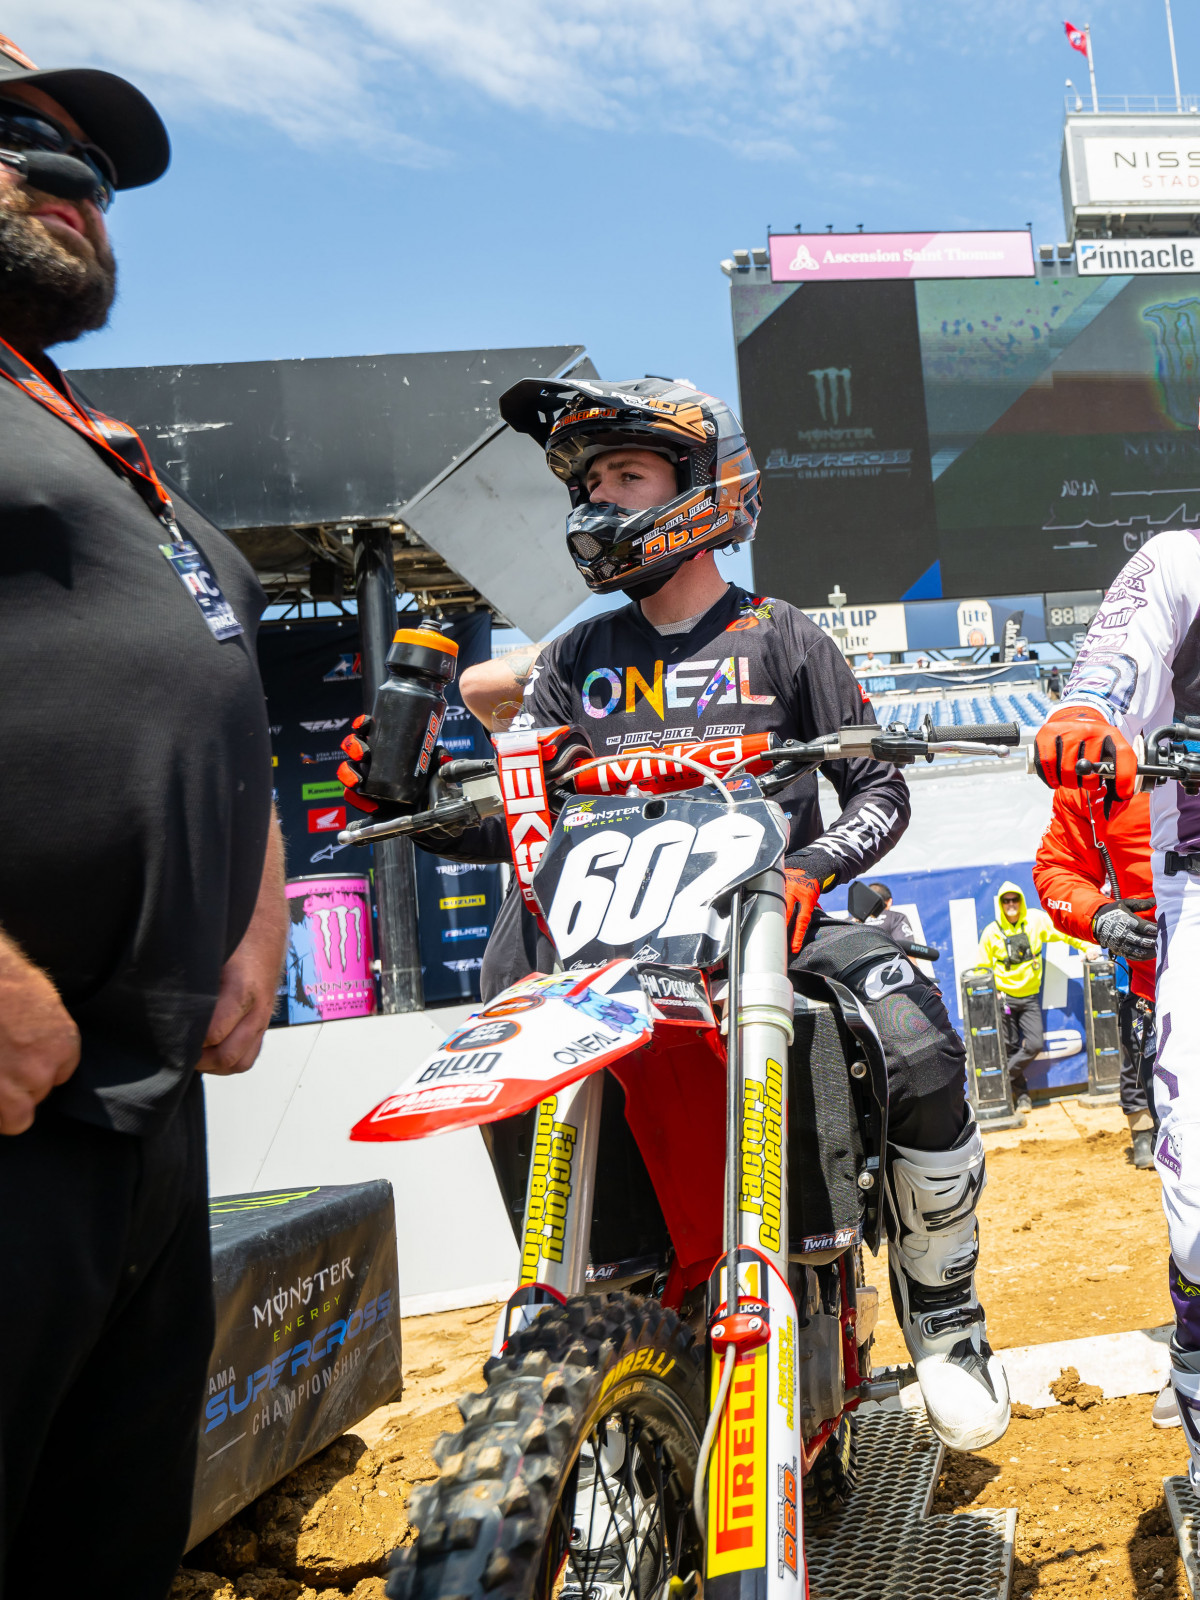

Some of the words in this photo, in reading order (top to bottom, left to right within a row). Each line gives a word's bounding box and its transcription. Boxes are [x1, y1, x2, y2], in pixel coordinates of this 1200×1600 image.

[823, 249, 900, 264] Ascension
[903, 248, 943, 262] Saint
[945, 247, 1005, 262] Thomas
[1082, 244, 1195, 270] Pinnacle
[808, 611, 845, 629] TAN
[850, 609, 877, 627] UP
[963, 609, 988, 626] Lite
[445, 739, 472, 748] YAMAHA
[623, 731, 652, 745] DIRT
[662, 727, 695, 740] BIKE
[704, 724, 745, 737] DEPOT
[307, 786, 345, 795] Kawasaki
[615, 770, 699, 791] Metals
[501, 755, 550, 885] EKS
[592, 806, 641, 823] NSTER
[549, 813, 766, 961] 602
[443, 897, 482, 907] SUZUKI
[910, 944, 929, 954] RODE
[317, 991, 369, 1002] ENERGY
[738, 1077, 765, 1215] Factory
[758, 1057, 783, 1253] Connection
[540, 1122, 578, 1264] Factory
[802, 1235, 833, 1251] Twin
[834, 1228, 857, 1246] Air
[252, 1256, 355, 1330] MONSTER
[273, 1294, 341, 1343] ENERGY
[204, 1289, 392, 1434] SUPERCROSS
[600, 1346, 676, 1397] PIRELLI
[208, 1365, 237, 1396] AMA
[252, 1347, 361, 1437] CHAMPIONSHIP
[715, 1352, 757, 1555] PIRELLI
[783, 1466, 798, 1578] DBD
